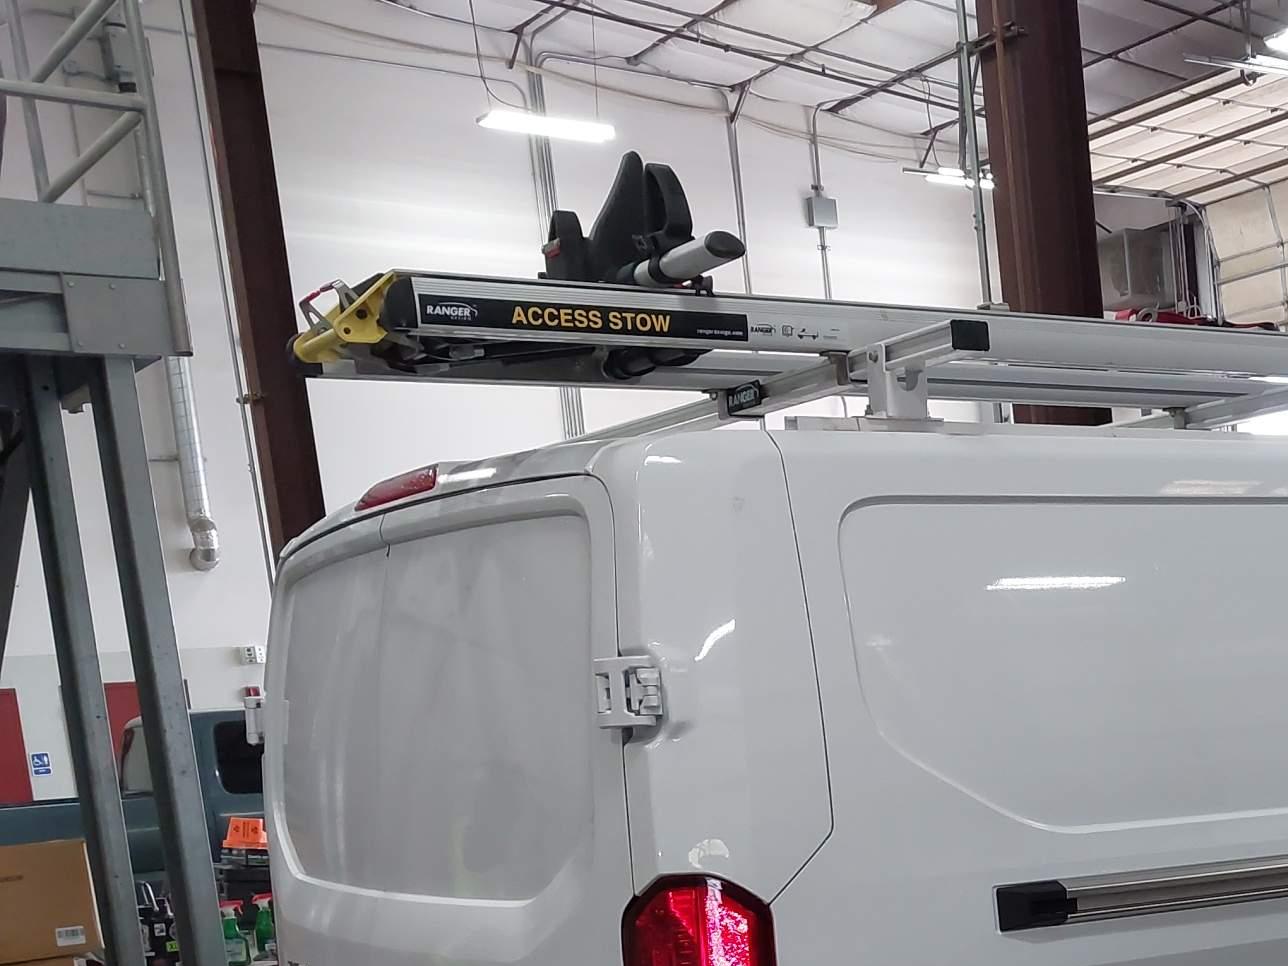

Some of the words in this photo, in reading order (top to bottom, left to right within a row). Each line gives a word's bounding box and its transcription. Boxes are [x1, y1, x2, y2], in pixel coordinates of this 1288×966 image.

[426, 304, 471, 317] RANGER
[511, 306, 603, 329] ACCESS
[608, 311, 671, 333] STOW
